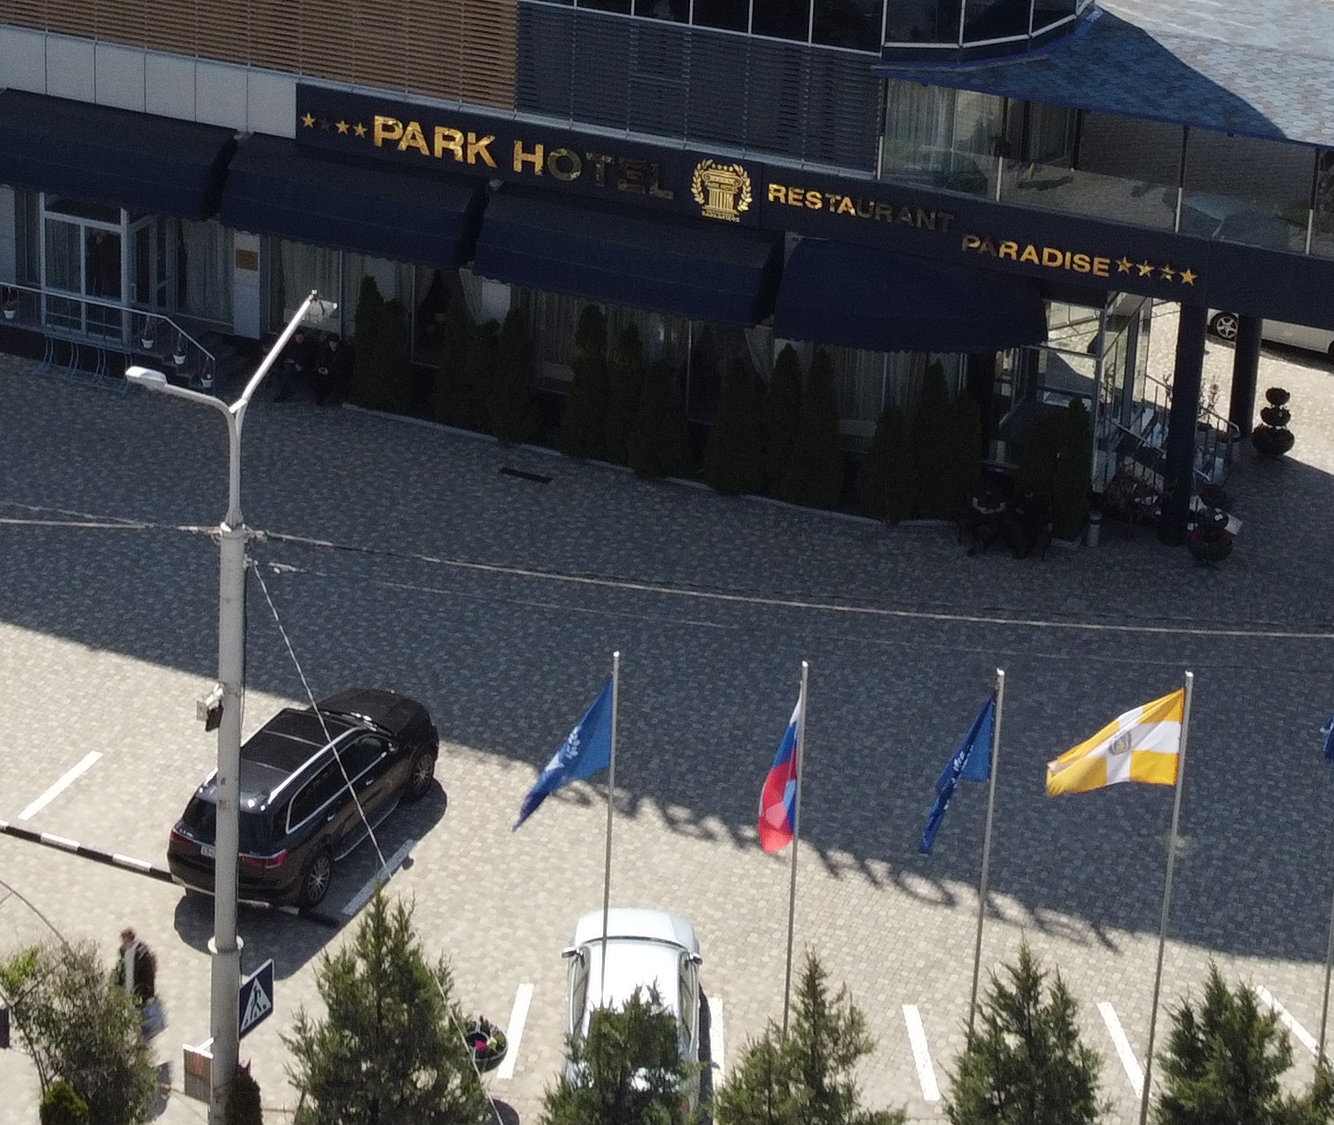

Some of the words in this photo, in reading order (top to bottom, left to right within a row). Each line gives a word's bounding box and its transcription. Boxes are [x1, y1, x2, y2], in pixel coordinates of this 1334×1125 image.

[373, 114, 497, 168] PARK
[513, 139, 675, 201] HOTEL
[768, 183, 955, 233] RESTAURANT
[961, 234, 1110, 277] PARADISE
